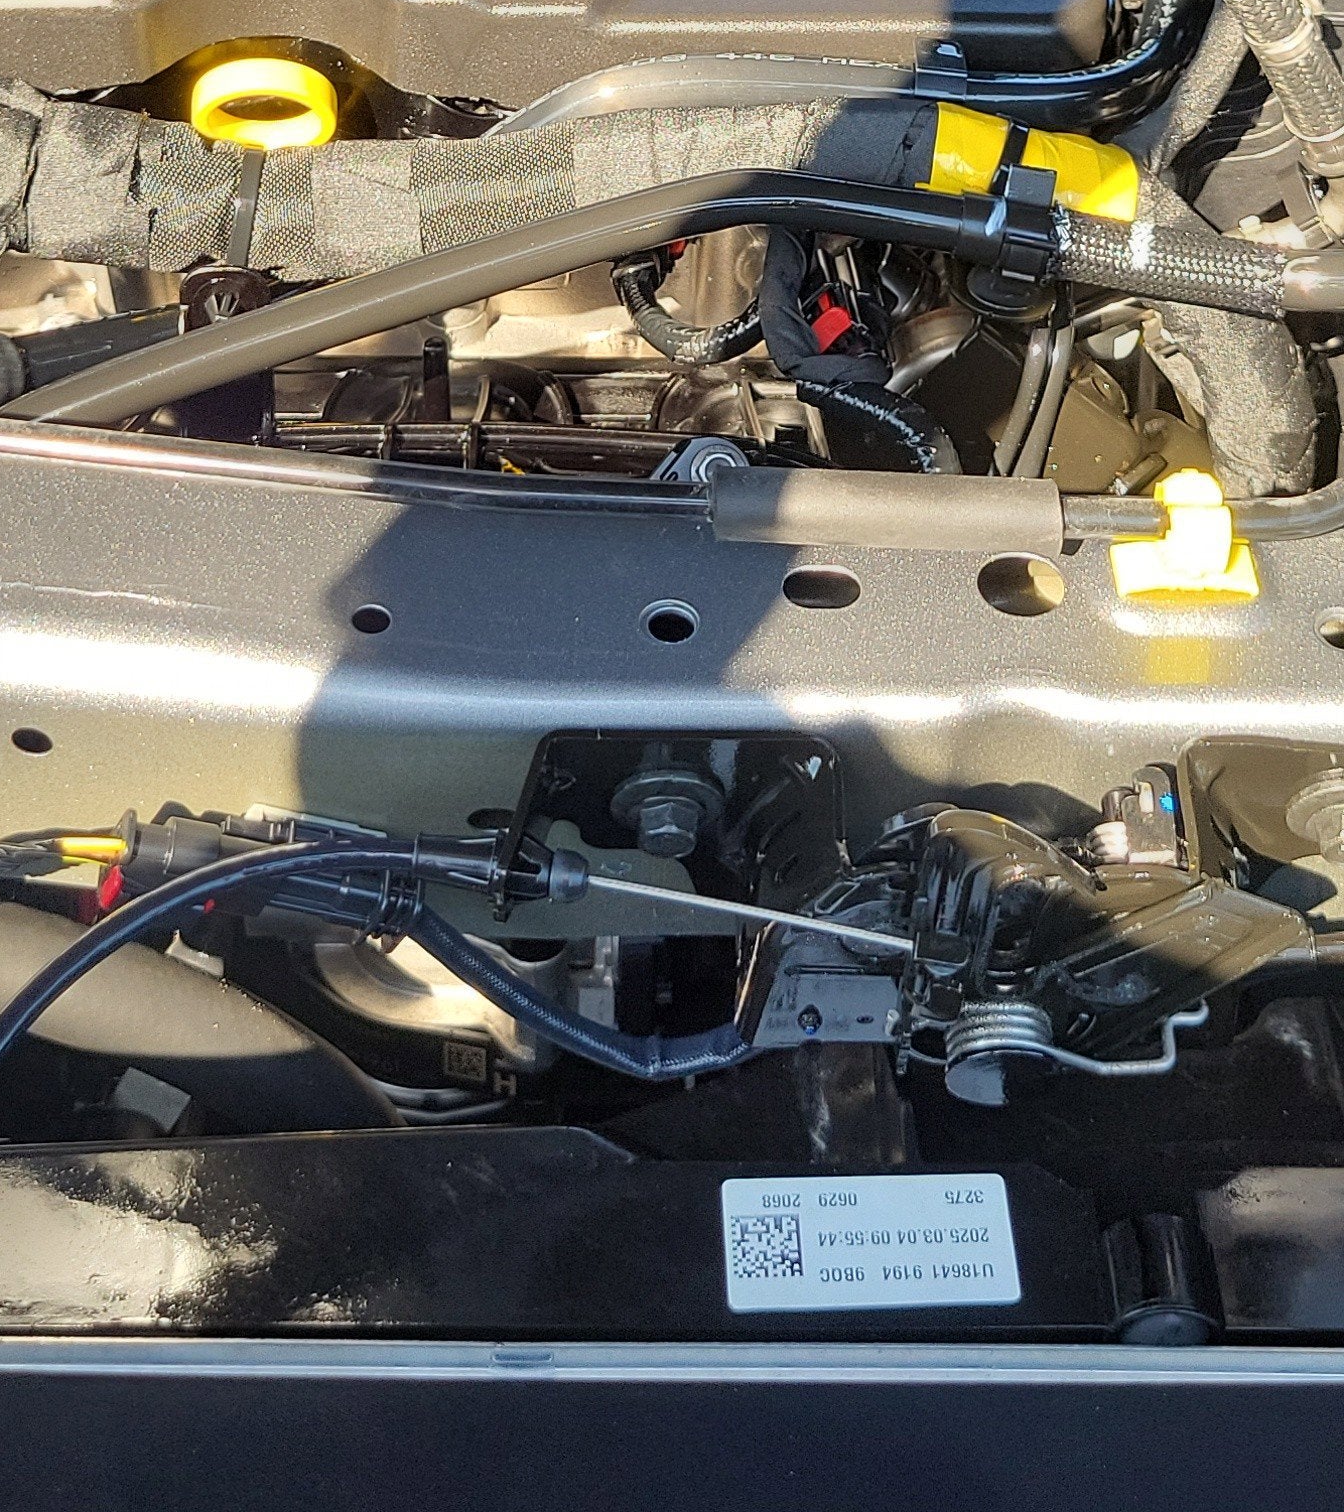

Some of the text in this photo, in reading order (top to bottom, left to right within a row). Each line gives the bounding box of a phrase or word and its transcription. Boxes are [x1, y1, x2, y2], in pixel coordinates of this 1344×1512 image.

[761, 1189, 985, 1208] 3275 0629 2068
[817, 1227, 990, 1247] 2025.03.04 09:55:44
[882, 1264, 923, 1281] 9194
[931, 1262, 995, 1280] U18641
